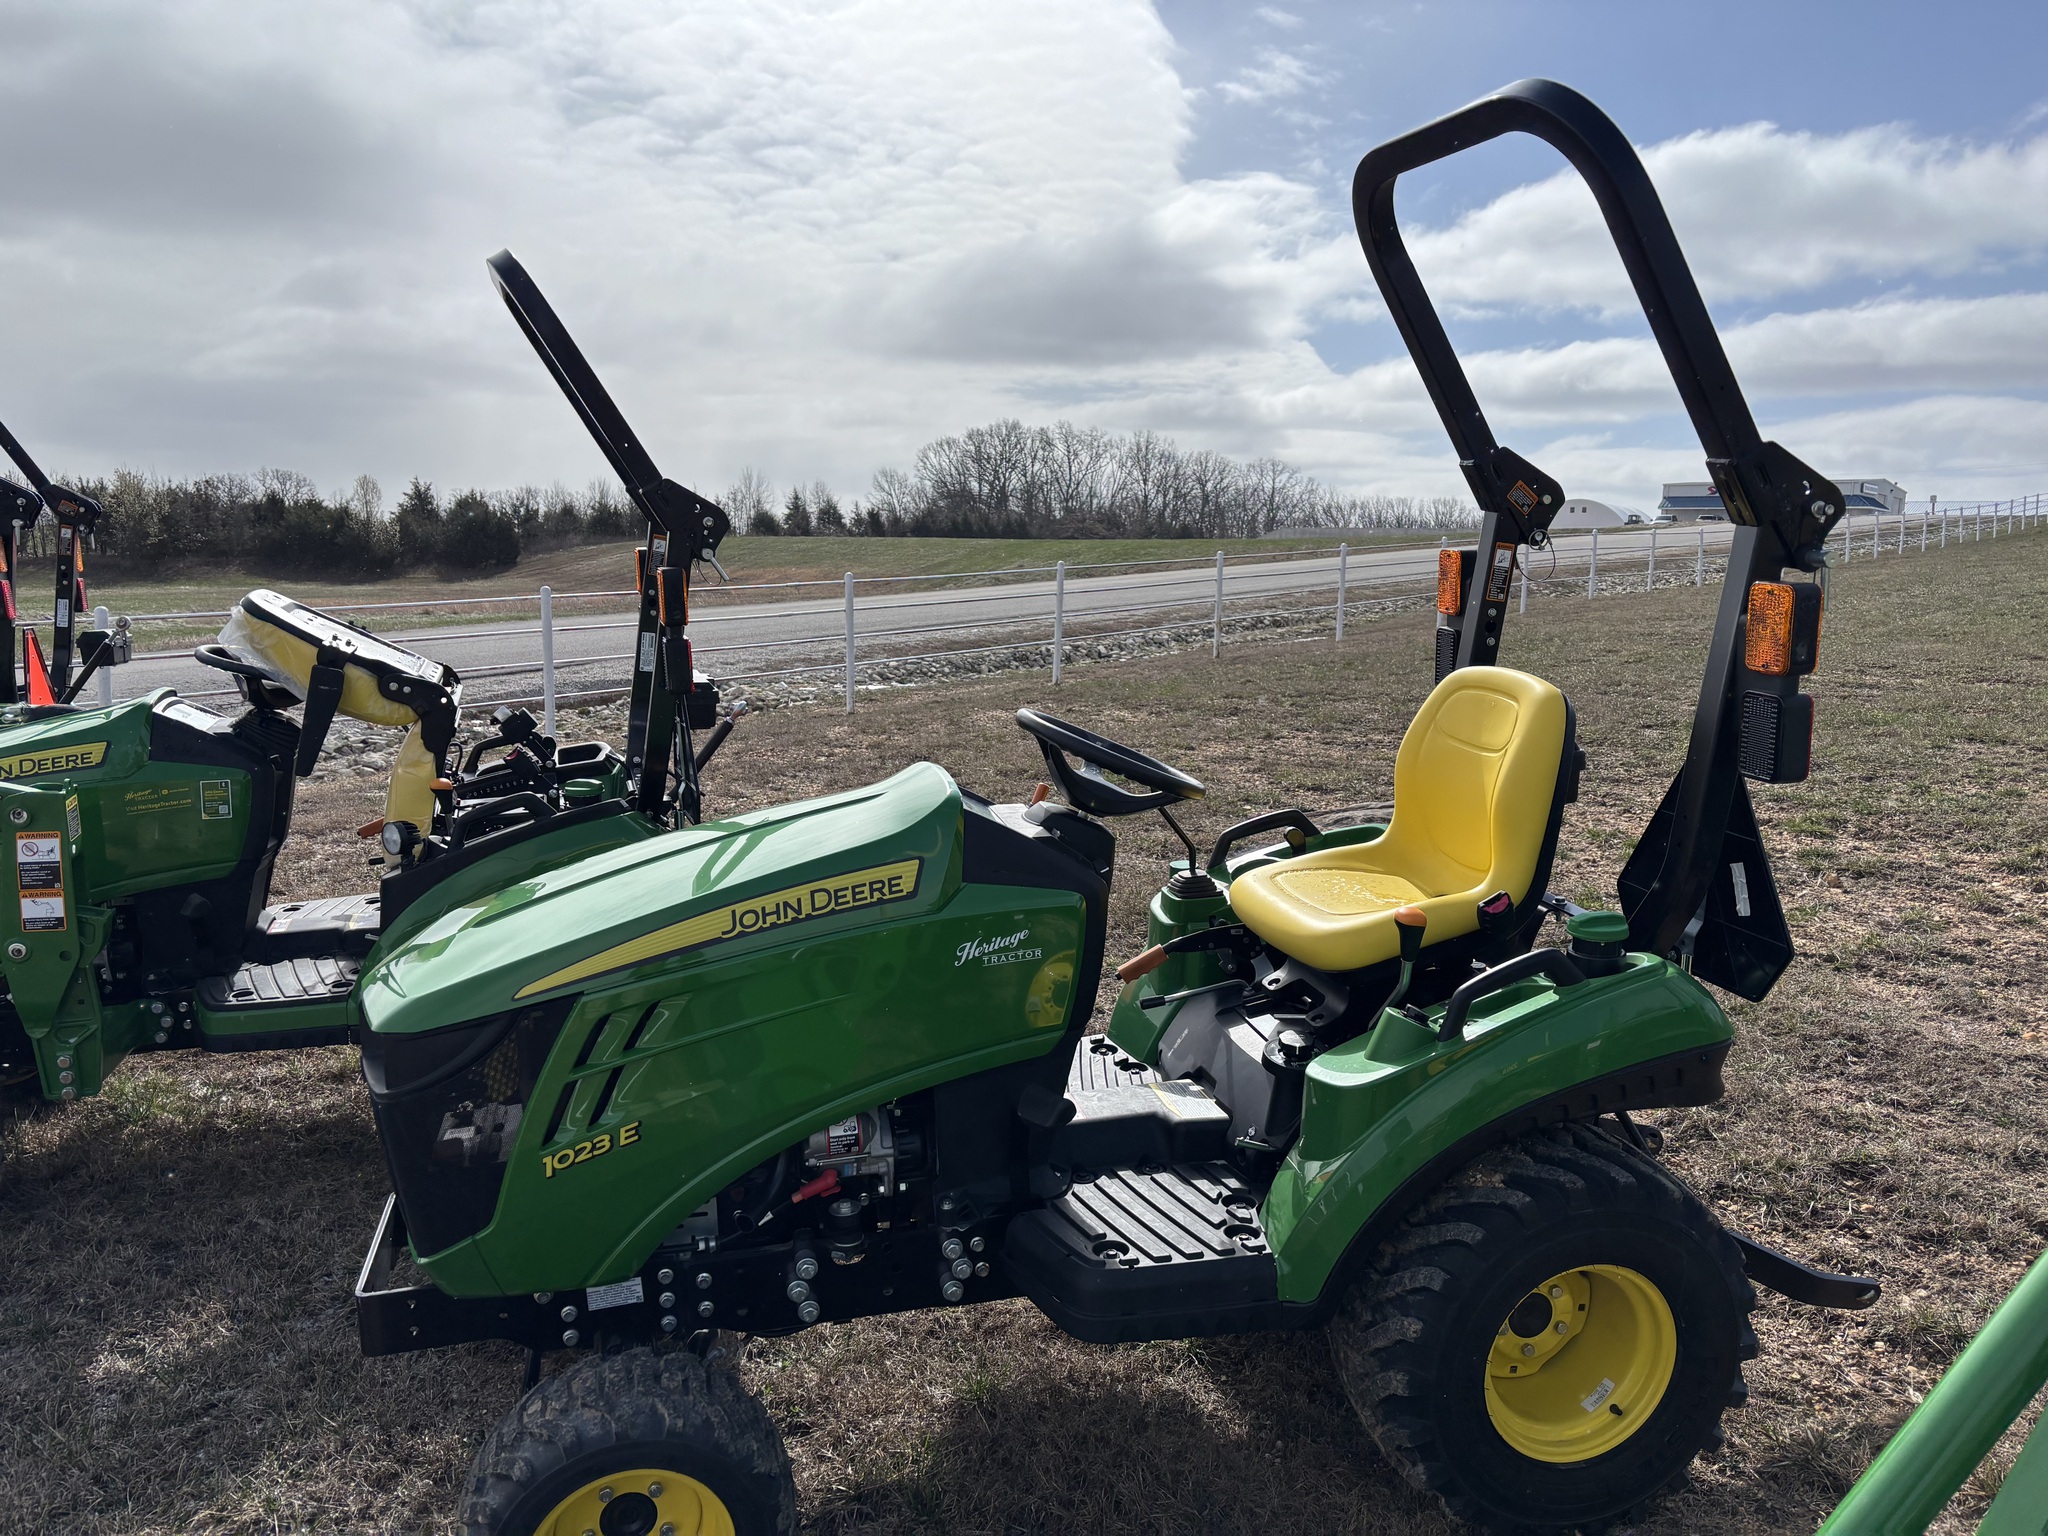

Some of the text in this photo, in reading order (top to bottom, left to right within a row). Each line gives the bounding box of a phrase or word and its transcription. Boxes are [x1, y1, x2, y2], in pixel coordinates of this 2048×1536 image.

[19, 752, 94, 774] DEERE
[721, 875, 904, 936] JOHN DEERE
[954, 929, 1030, 967] Heritage
[982, 949, 1042, 965] TRACTOR
[542, 1121, 639, 1178] 1023 E
